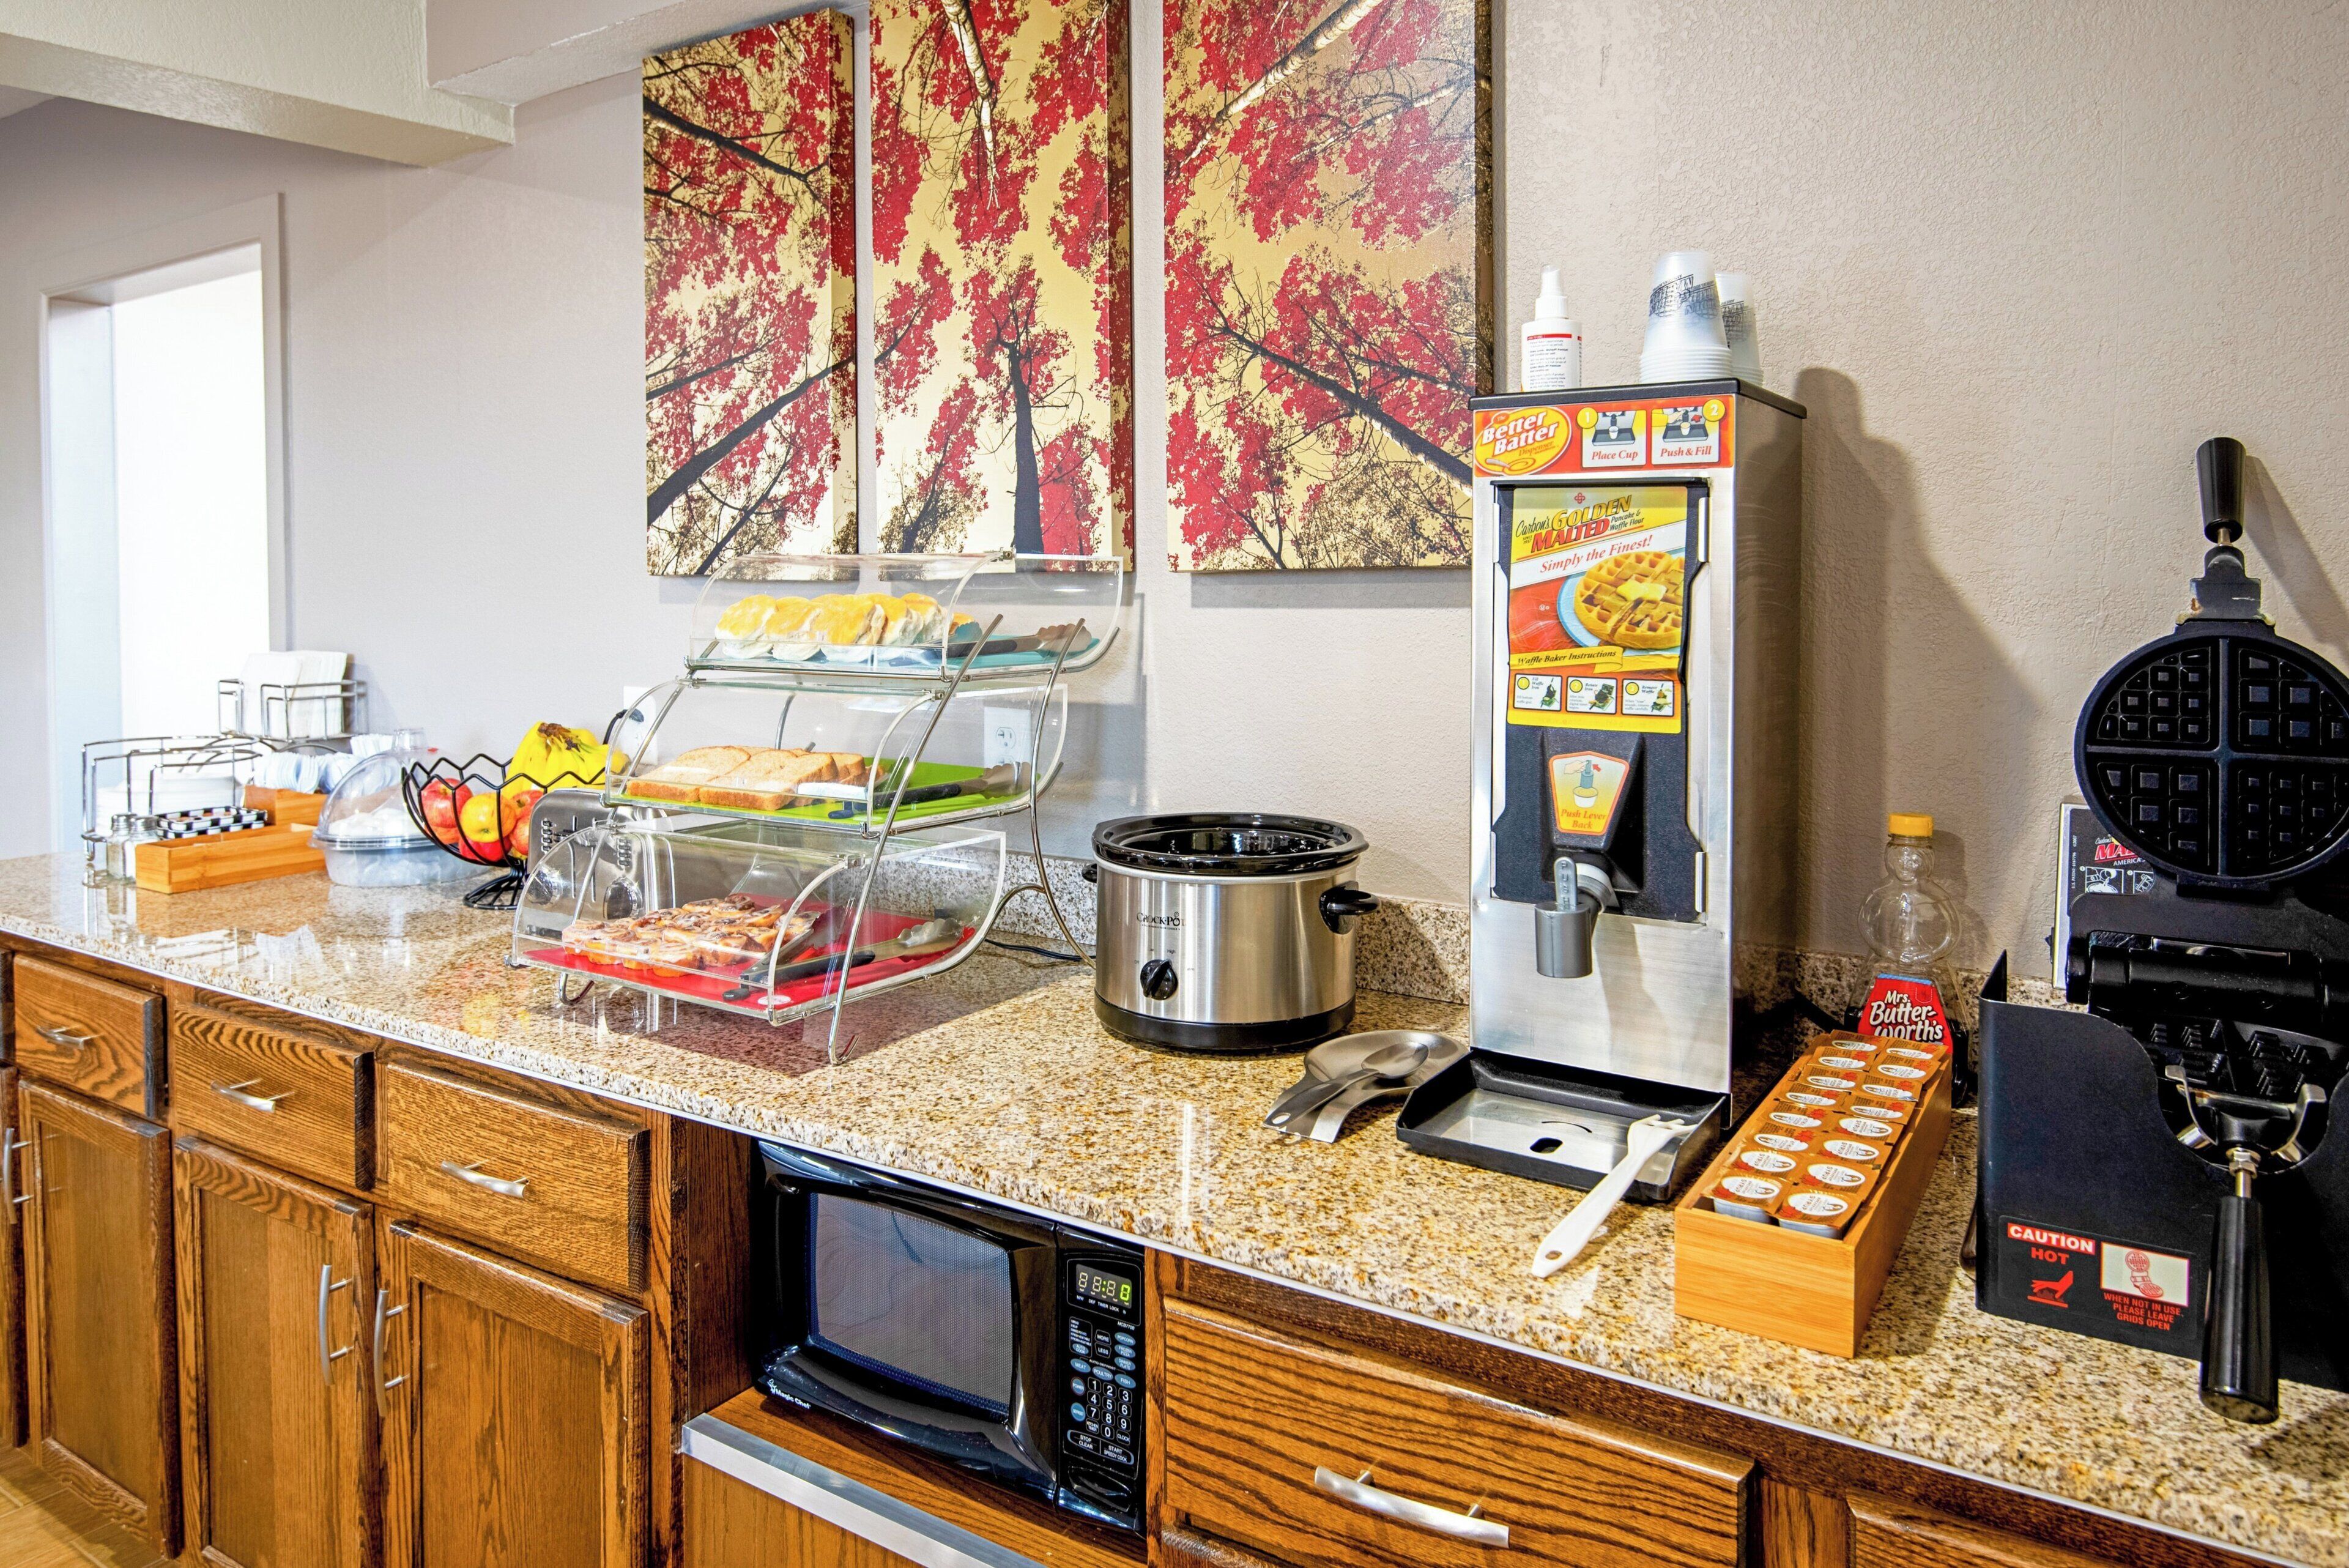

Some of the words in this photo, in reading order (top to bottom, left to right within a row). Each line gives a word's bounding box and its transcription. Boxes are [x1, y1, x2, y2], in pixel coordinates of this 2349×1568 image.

[1711, 404, 1718, 417] 2
[1585, 412, 1590, 423] 1
[1481, 411, 1548, 445] Better
[1493, 422, 1559, 457] Batter
[1519, 440, 1554, 456] Dispenser
[1660, 447, 1683, 457] Push
[1696, 445, 1712, 455] Fill
[1592, 451, 1616, 460] Place
[1619, 450, 1638, 461] Cup
[1516, 516, 1549, 538] Carbon's
[1552, 494, 1632, 531] GOLDEN
[1611, 511, 1635, 523] Pancake
[1610, 521, 1628, 531] Waffle
[1630, 518, 1644, 526] Flour
[1531, 518, 1609, 553] MALTED
[1540, 555, 1583, 573] Simply
[1587, 548, 1606, 562] the
[1609, 535, 1653, 557] Finest!
[1518, 653, 1543, 665] Waffle
[1544, 654, 1567, 663] Baker
[1568, 650, 1616, 661] Instructions
[1560, 809, 1581, 817] Push
[1583, 811, 1606, 820] Lever
[1572, 820, 1593, 829] Back
[1884, 990, 1910, 1003] Mrs.
[1869, 1001, 1937, 1026] Butter-
[2009, 1225, 2093, 1252] CAUTION
[2031, 1247, 2069, 1265] HOT
[2104, 1292, 2130, 1304] WHEN
[2132, 1298, 2150, 1309] NOT
[2152, 1302, 2161, 1312] IN
[2113, 1303, 2145, 1317] PLEASE
[2148, 1310, 2174, 1323] LEAVE
[2117, 1312, 2144, 1325] GRIDS
[2146, 1319, 2170, 1331] OPEN
[1097, 1334, 1110, 1342] MORE
[1117, 1335, 1133, 1343] POPCORN
[1094, 1369, 1112, 1379] POULTRY
[1093, 1380, 1096, 1391] 1
[1107, 1385, 1113, 1396] 2
[776, 1389, 794, 1402] Magic
[795, 1398, 810, 1410] Chef
[1091, 1394, 1097, 1403] 4
[1123, 1391, 1129, 1401] 3
[1106, 1400, 1112, 1410] 5
[1122, 1405, 1128, 1414] 6
[1090, 1408, 1096, 1418] 7
[1105, 1413, 1112, 1424] 8
[1121, 1419, 1127, 1429] 9
[1105, 1427, 1111, 1437] 0
[1117, 1433, 1130, 1443] CLOCK
[1079, 1440, 1093, 1450] CLEAR
[1108, 1445, 1123, 1454] START
[1104, 1450, 1117, 1458] SPEEDY
